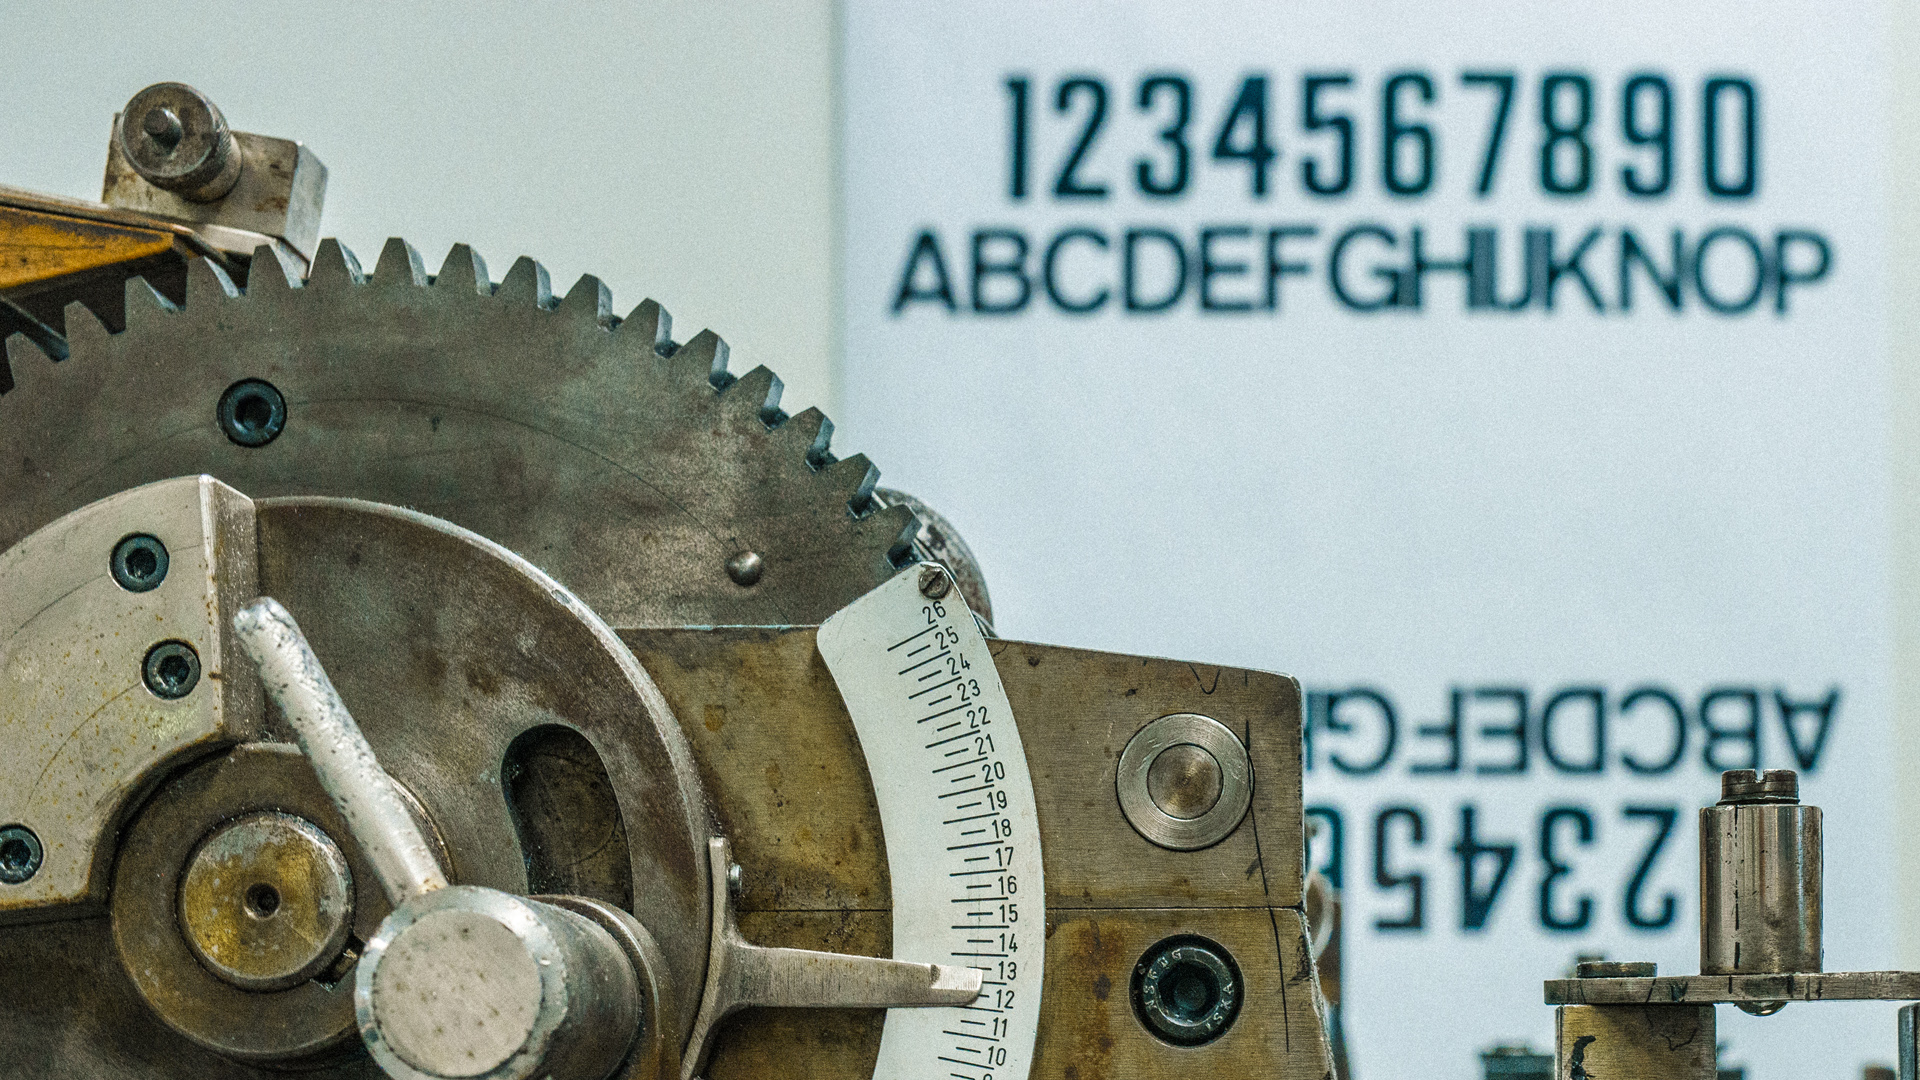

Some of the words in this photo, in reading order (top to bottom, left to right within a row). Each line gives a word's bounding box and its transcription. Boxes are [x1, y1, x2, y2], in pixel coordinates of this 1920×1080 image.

[1003, 70, 1760, 203] 1234567890
[922, 600, 946, 625] 26
[935, 626, 959, 650] 25
[947, 653, 971, 675] 24
[957, 679, 981, 701] 23
[967, 706, 991, 729] 22
[975, 734, 995, 755] 21
[982, 761, 1006, 783] 20
[987, 790, 1008, 811] 19
[992, 819, 1012, 838] 18
[996, 847, 1014, 866] 17
[998, 876, 1018, 895] 16
[999, 904, 1019, 923] 15
[999, 933, 1019, 952] 14
[999, 961, 1018, 980] 13
[996, 989, 1015, 1009] 12
[993, 1017, 1008, 1037] 11
[988, 1046, 1007, 1066] 10
